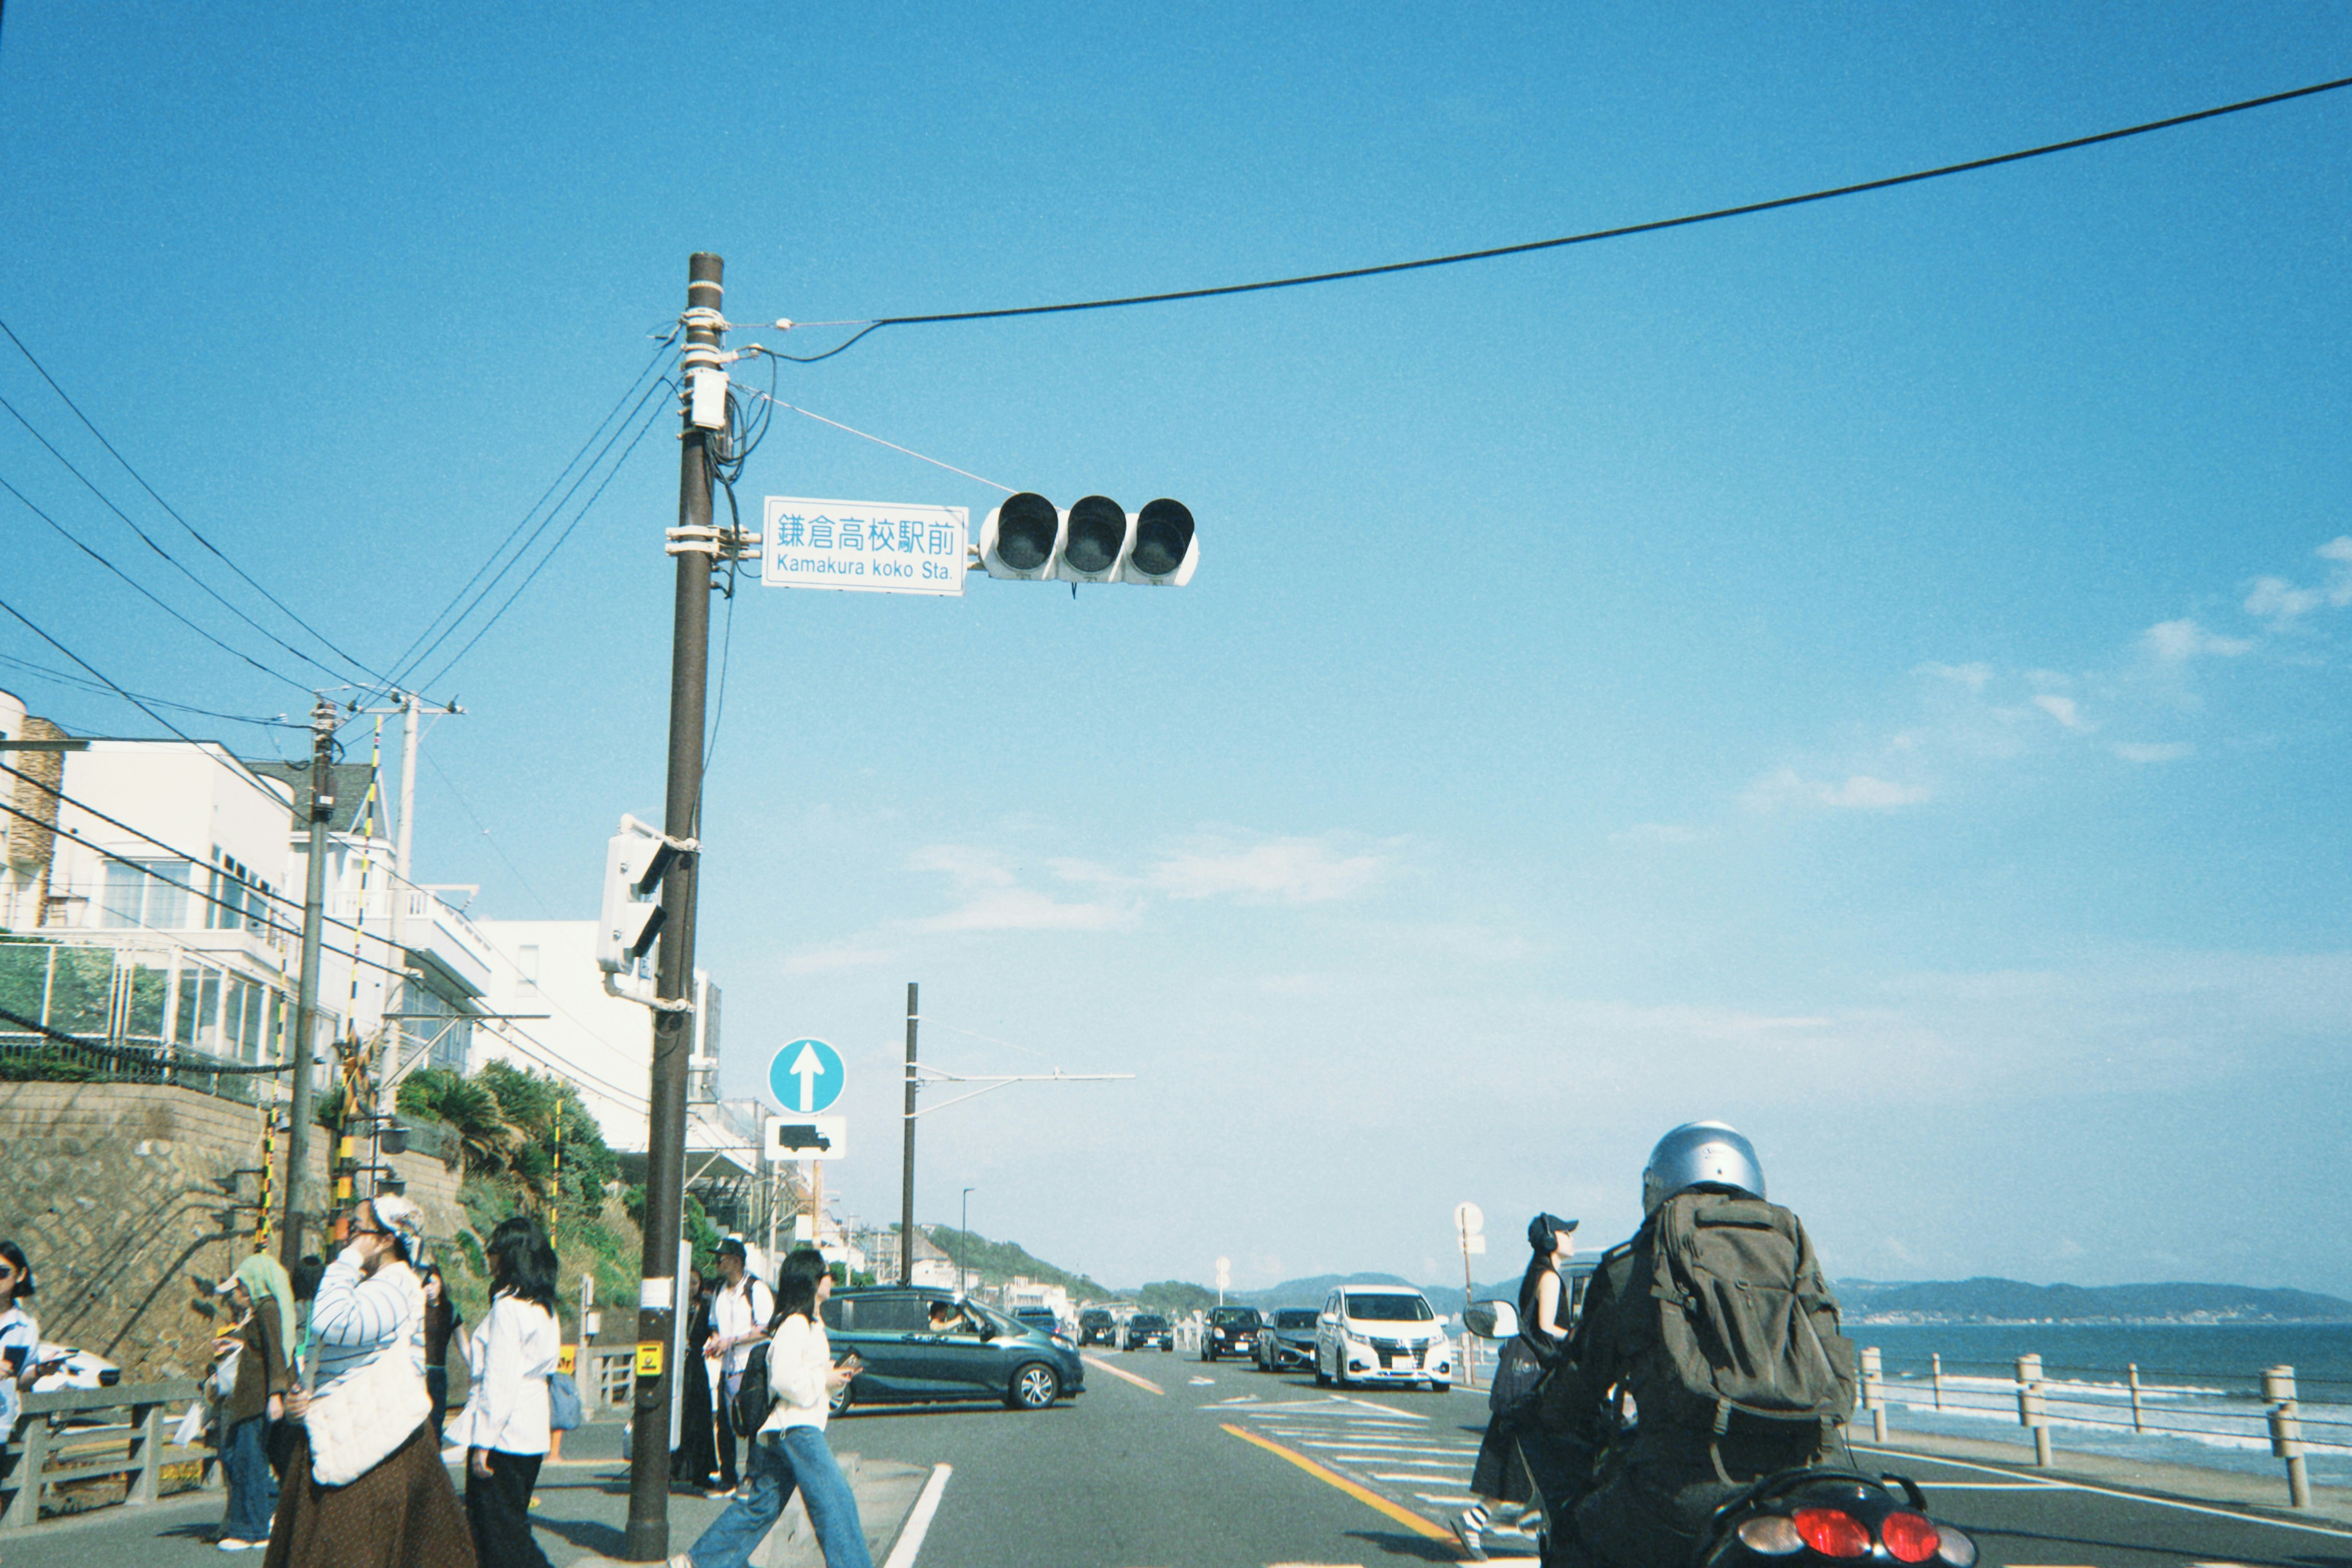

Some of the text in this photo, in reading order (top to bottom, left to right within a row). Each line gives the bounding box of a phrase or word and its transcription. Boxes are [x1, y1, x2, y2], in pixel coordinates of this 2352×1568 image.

[777, 513, 955, 555] 鎌倉高校駅前
[777, 554, 953, 580] Kamakura koko Sta.
